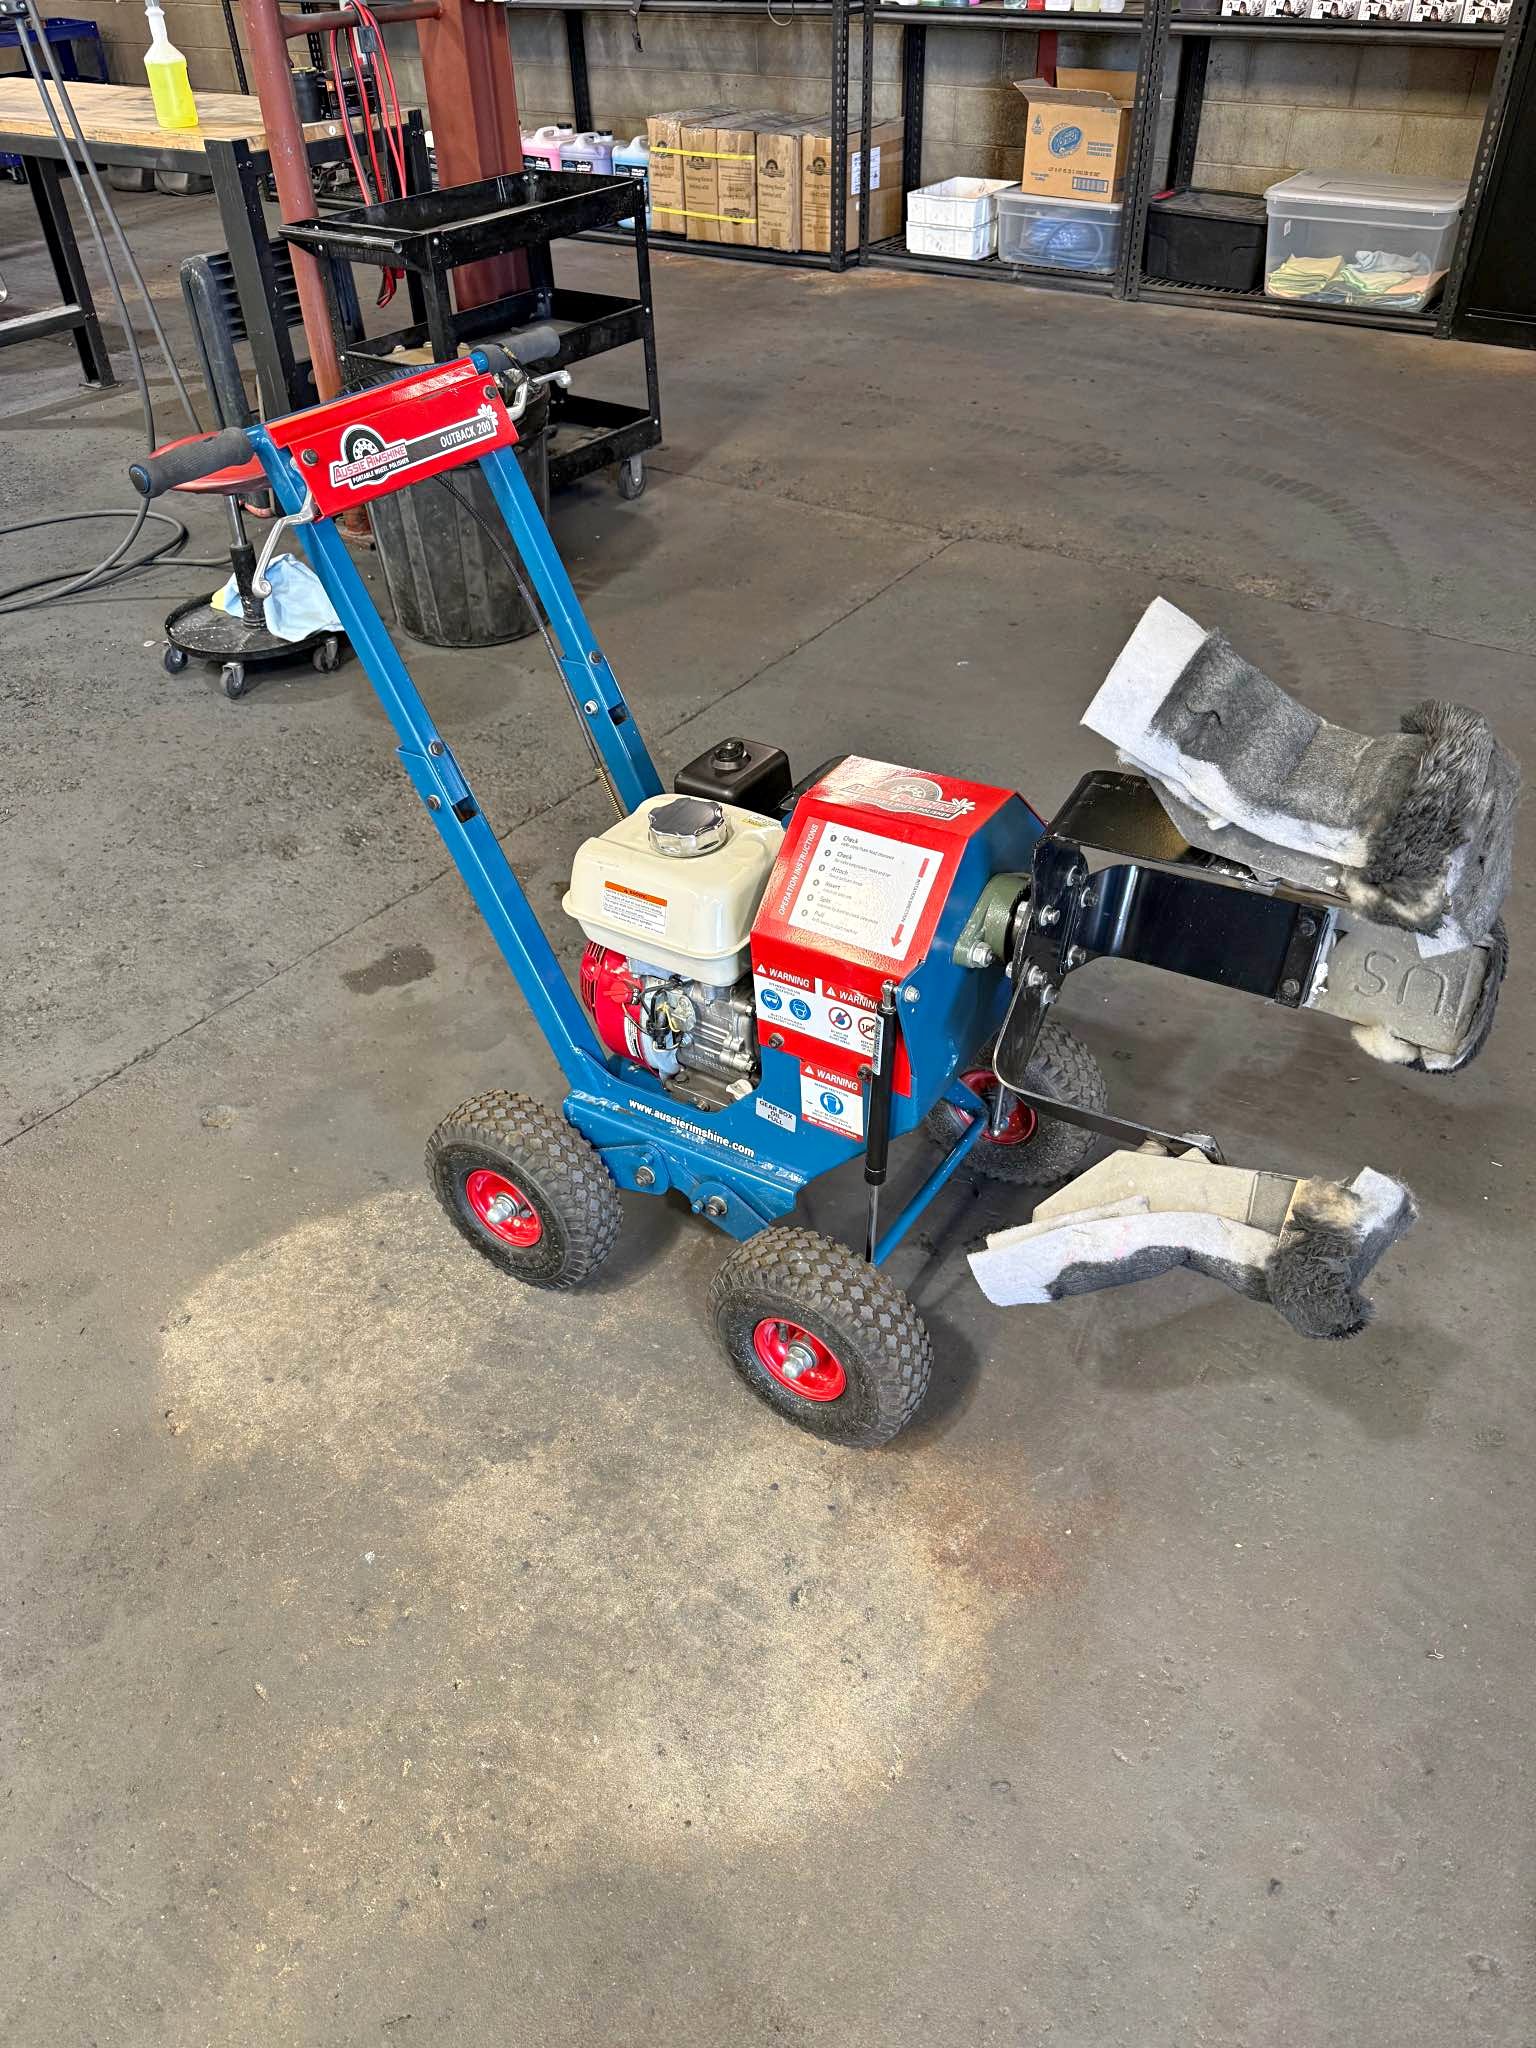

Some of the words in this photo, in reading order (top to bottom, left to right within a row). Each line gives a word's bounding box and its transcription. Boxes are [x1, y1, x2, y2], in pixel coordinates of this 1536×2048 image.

[440, 426, 476, 448] OUTBACK
[476, 420, 491, 435] 200
[335, 460, 365, 481] AUSSIE
[365, 445, 406, 468] RIMSHINE
[778, 874, 800, 916] OPERATION
[794, 824, 819, 874] INSTRUCTIONS
[769, 967, 810, 988] WARNING
[817, 1069, 859, 1091] WARNING
[759, 1099, 778, 1113] GEAR
[778, 1107, 793, 1120] BOX
[767, 1114, 784, 1126] FULL
[770, 1110, 782, 1120] OIL
[628, 1098, 755, 1158] www.aussierimshine.com
